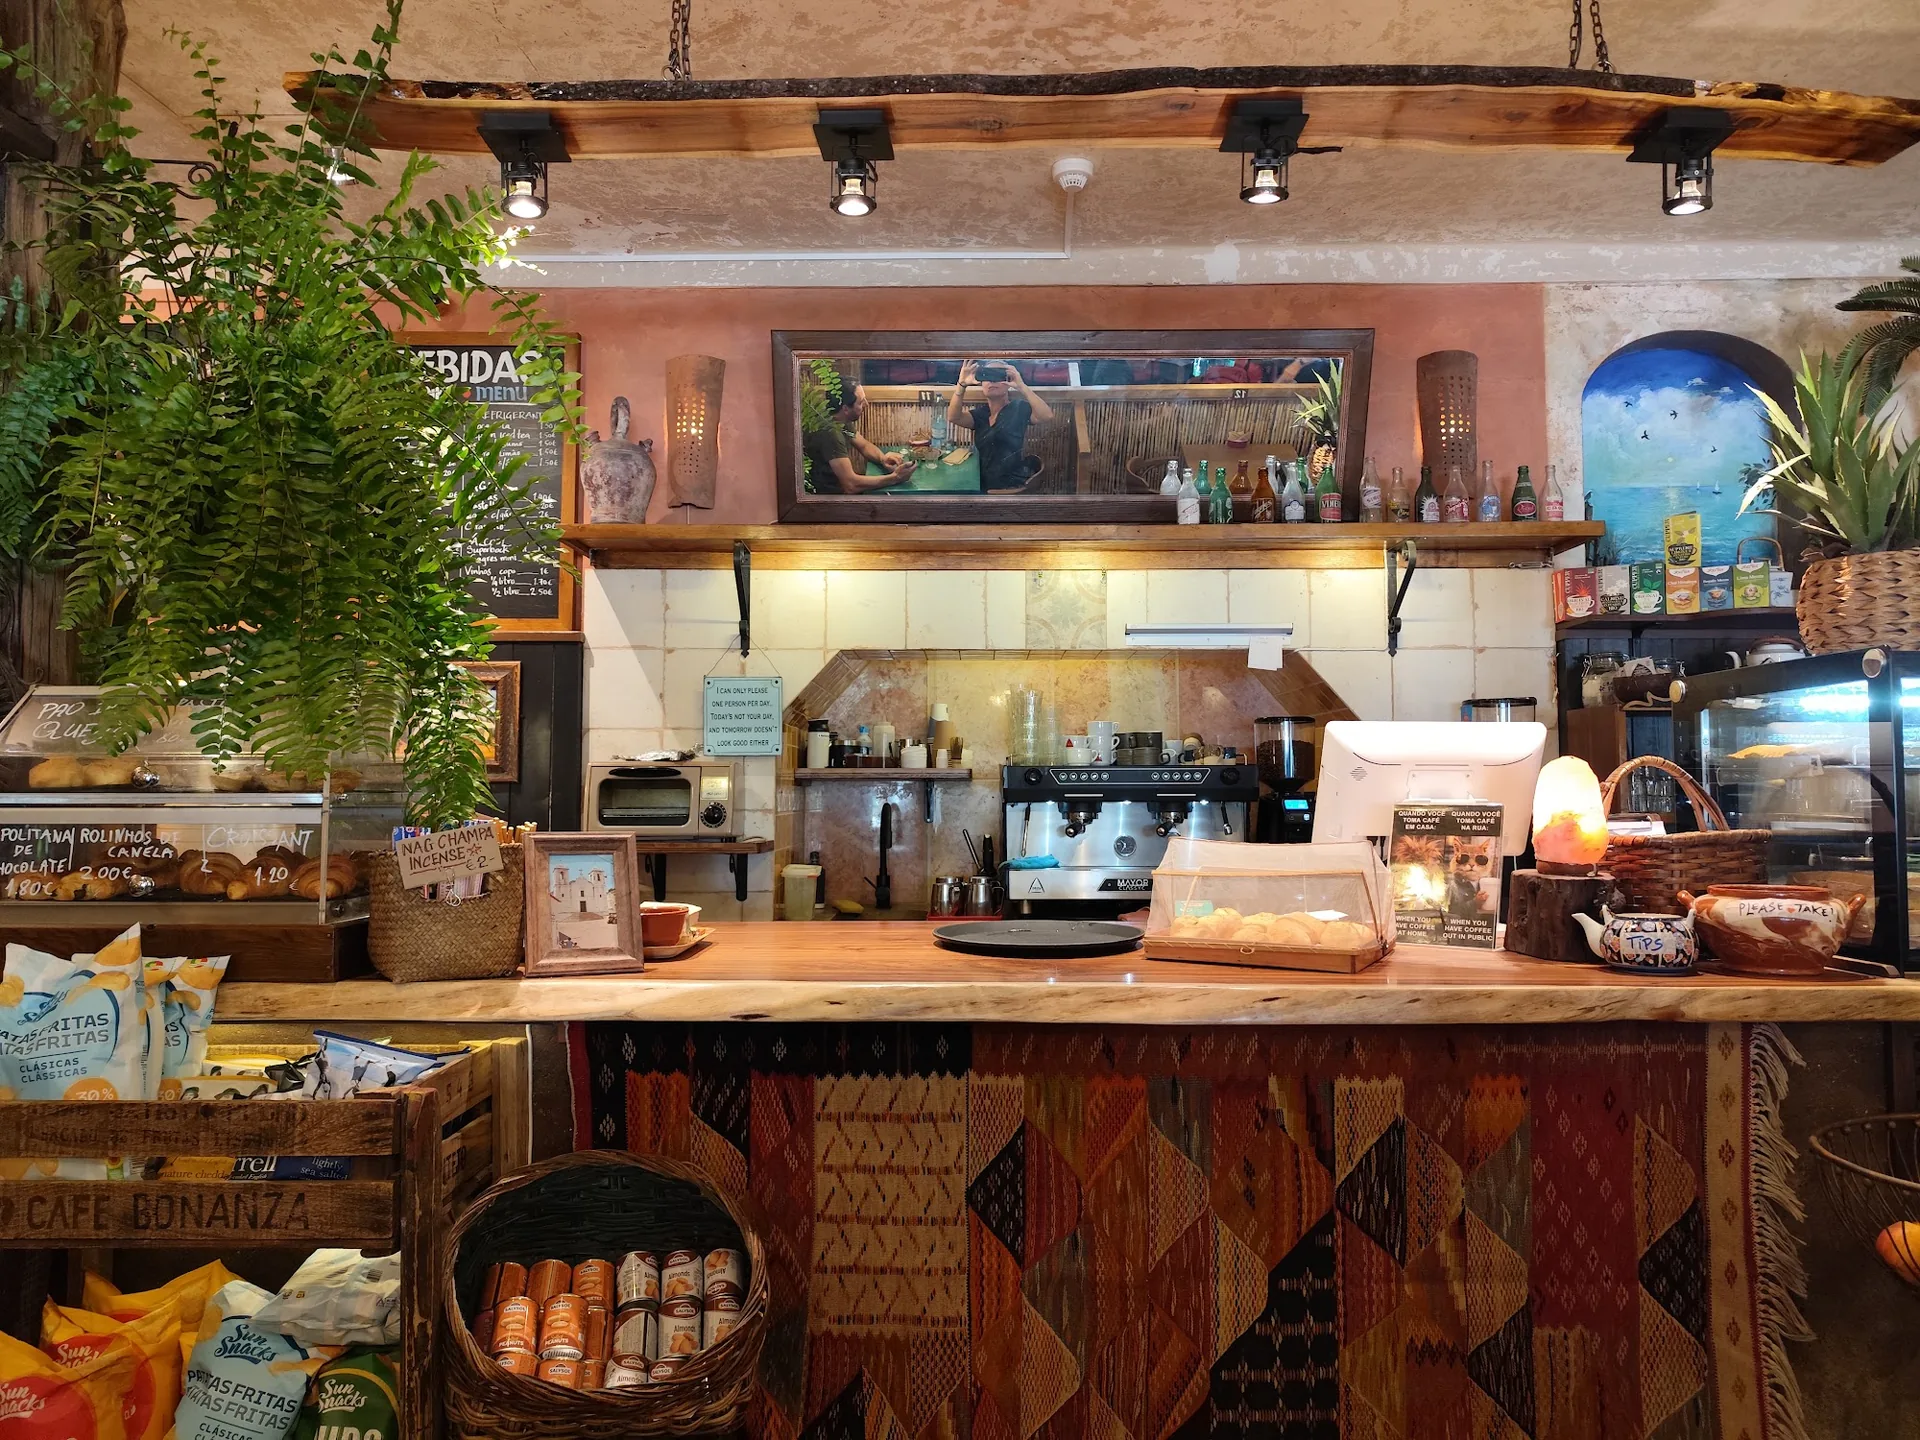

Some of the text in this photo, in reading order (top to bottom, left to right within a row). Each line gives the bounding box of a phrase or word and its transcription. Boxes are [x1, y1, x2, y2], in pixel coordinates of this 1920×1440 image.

[398, 350, 543, 384] EBIDAS
[482, 410, 544, 420] EFRIGERANT
[464, 565, 492, 576] Vinhos
[711, 700, 724, 708] ONE
[0, 827, 72, 844] POLITANA
[80, 827, 152, 844] ROLINHOS
[206, 827, 314, 856] CROISSANT
[401, 826, 495, 856] NAG CHAMPA
[13, 844, 33, 857] DE
[107, 846, 174, 859] CANELA
[409, 846, 466, 870] INCENSE
[0, 858, 68, 876] HOCOLATE
[1117, 878, 1149, 886] MAYOR
[1739, 902, 1783, 917] PLEASE
[1464, 926, 1492, 934] COFFEE
[20, 1057, 80, 1073] CLÁSICAS
[21, 1066, 88, 1084] CLÁSSICAS
[232, 1155, 278, 1172] rrell
[312, 1156, 343, 1171] lightly
[300, 1166, 349, 1180] sea salted
[132, 1191, 310, 1231] BONANZA
[230, 1323, 268, 1347] Sun
[673, 1324, 697, 1334] Almonds
[57, 1343, 92, 1364] Sun
[213, 1334, 280, 1363] Snacks
[319, 1378, 355, 1400] Sun
[0, 1396, 47, 1415] nacks
[199, 1422, 253, 1440] CLÁSICA
